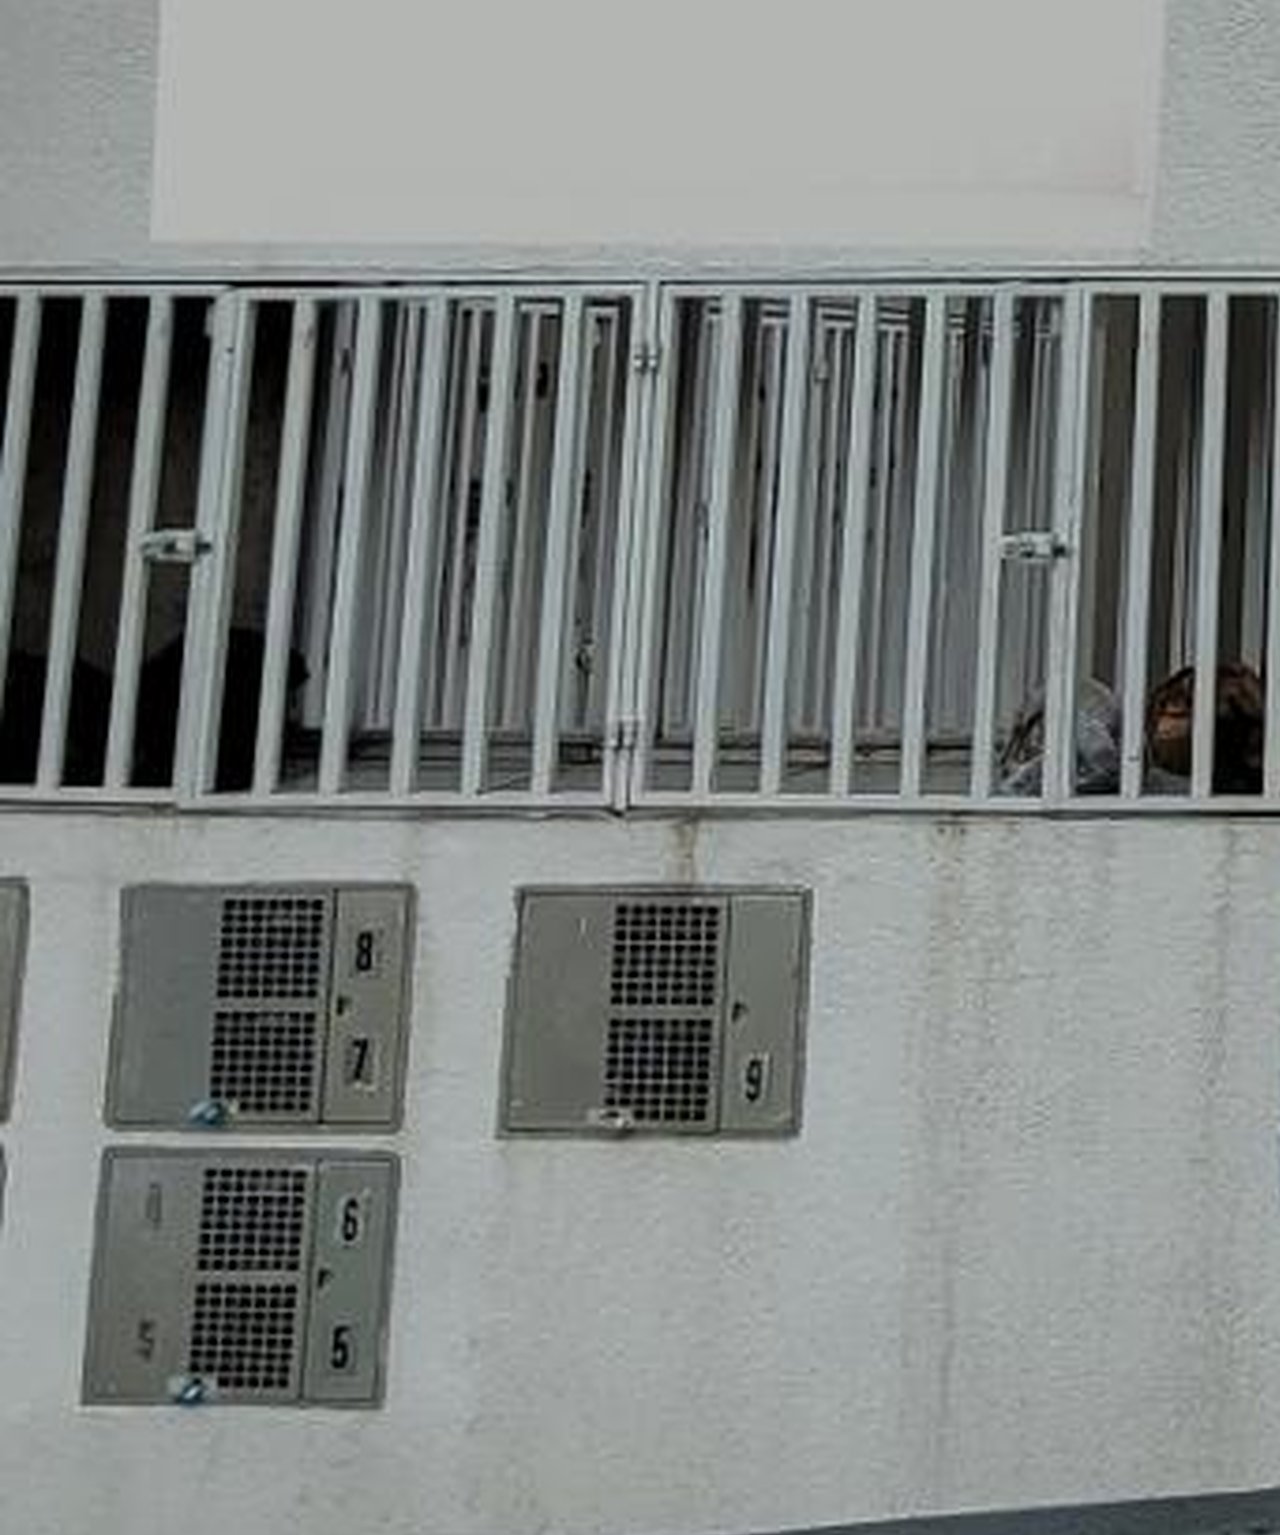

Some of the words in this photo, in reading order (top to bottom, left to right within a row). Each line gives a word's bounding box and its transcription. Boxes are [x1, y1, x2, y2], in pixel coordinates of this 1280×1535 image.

[355, 931, 373, 972] 8
[352, 1038, 369, 1079] 7
[745, 1059, 762, 1102] 9
[342, 1197, 359, 1242] 6
[331, 1325, 353, 1370] 5
